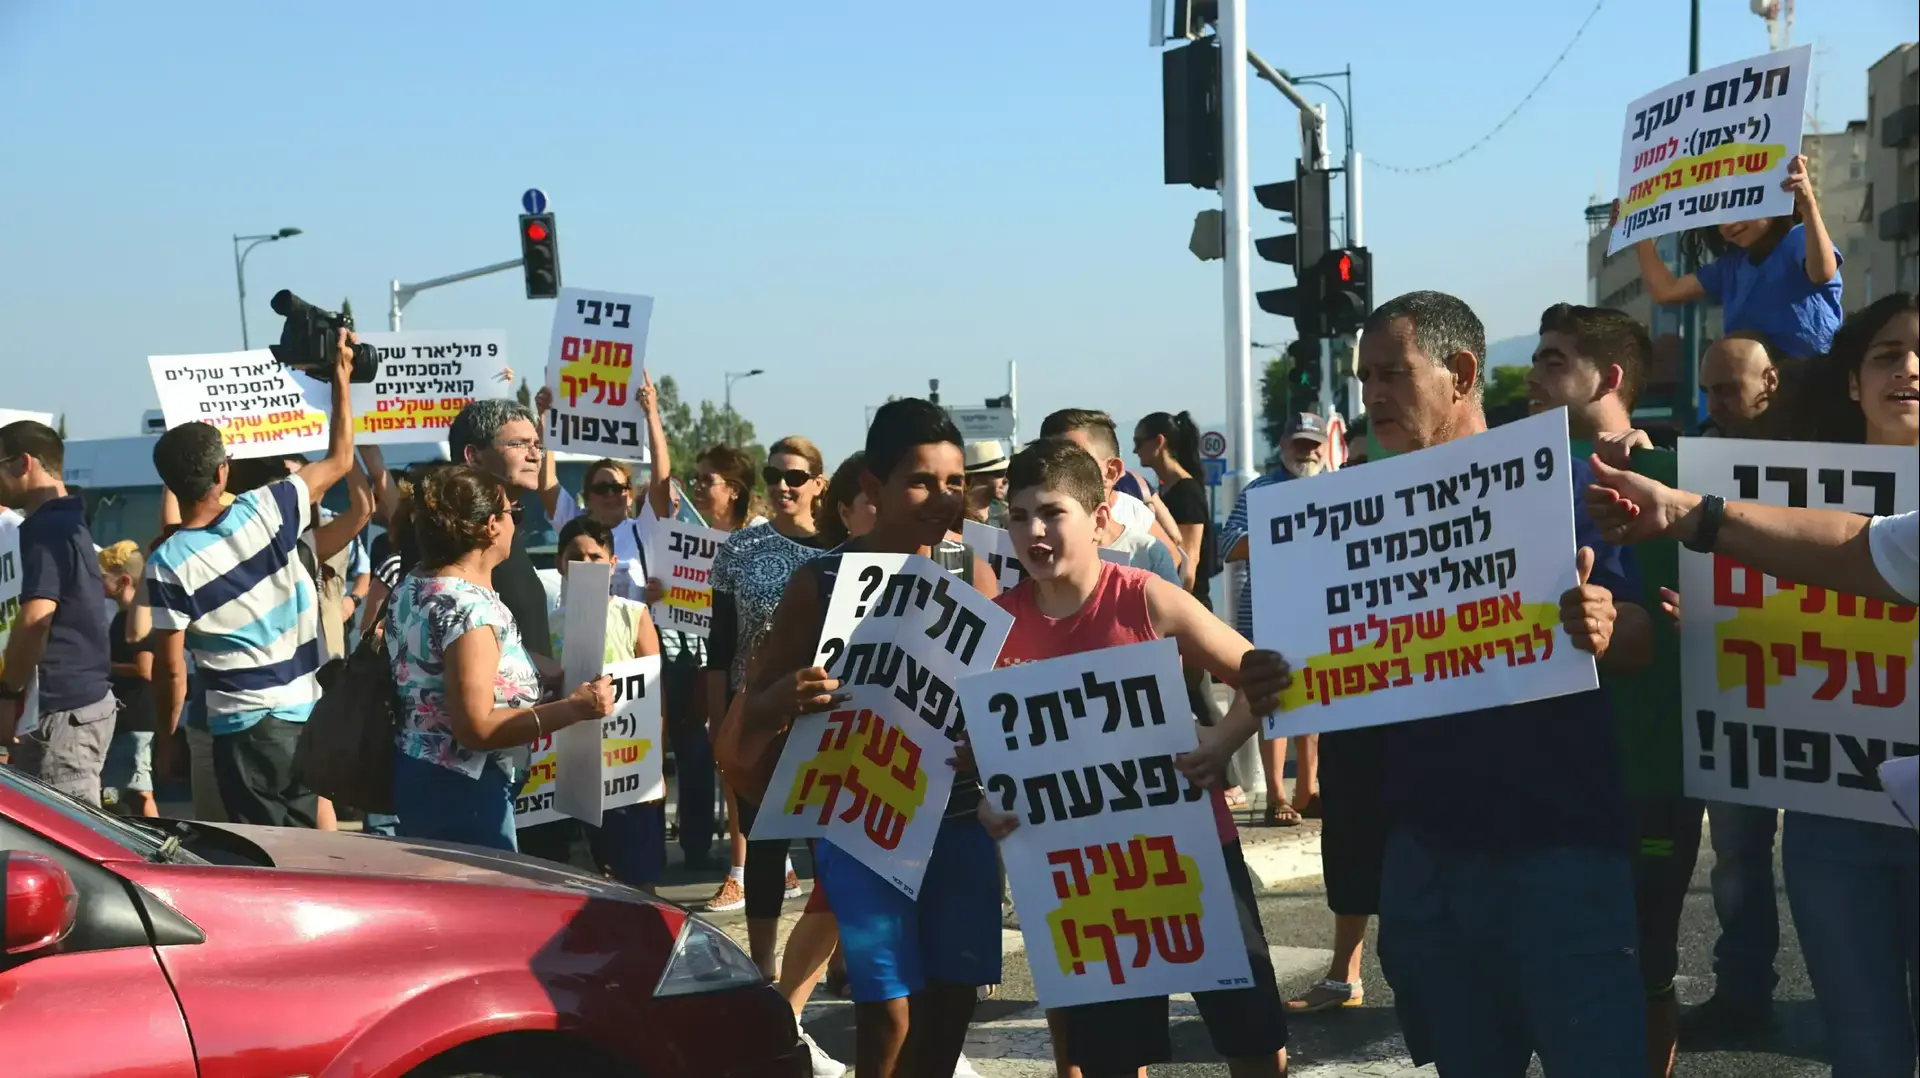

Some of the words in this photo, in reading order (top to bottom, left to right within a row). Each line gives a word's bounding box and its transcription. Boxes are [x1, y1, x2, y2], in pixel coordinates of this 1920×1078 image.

[1703, 66, 1790, 113] חלום
[1632, 90, 1695, 141] יעקב
[1683, 113, 1771, 156] (ליצמן):
[1633, 136, 1679, 173] למנוע
[1690, 152, 1768, 183] שירותי
[1627, 168, 1683, 204] בריאות
[1678, 185, 1764, 216] מתושבי
[1622, 202, 1672, 238] הצפון!
[576, 299, 631, 328] ביבי
[412, 343, 482, 358] מיליארד
[487, 343, 498, 357] 9
[561, 336, 633, 368] מתים
[165, 366, 223, 383] שקלים
[207, 376, 285, 396] להסכמים
[376, 378, 474, 395] קואליציונים
[386, 360, 462, 377] להסכמים
[200, 393, 301, 412] קואליציונים
[376, 397, 434, 414] שקלים
[562, 373, 627, 408] עליך
[253, 421, 323, 442] לבריאות
[268, 409, 305, 424] אפס
[364, 416, 416, 433] בצפון!
[550, 408, 639, 446] בצפון!
[1204, 438, 1221, 452] 60
[1534, 447, 1554, 481] 9
[1395, 457, 1525, 517] מיליארד
[1270, 495, 1384, 545] שקלים
[1346, 505, 1492, 571] להסכמים
[668, 531, 723, 560] עקב
[672, 565, 710, 583] מנוע
[1326, 548, 1517, 615] קואליציונים
[670, 586, 712, 608] ריאות
[1456, 591, 1523, 632] אפס
[854, 565, 987, 667] חלית?
[1328, 607, 1446, 656] שקלים
[1424, 622, 1554, 683] לבריאות
[1723, 631, 1906, 709] עליך
[1303, 656, 1413, 706] בצפון!
[988, 671, 1166, 751] חלית?
[817, 709, 923, 791] בעיה
[793, 765, 907, 851] שלך!
[1046, 835, 1187, 900] בעיה
[1060, 908, 1204, 985] שלך!
